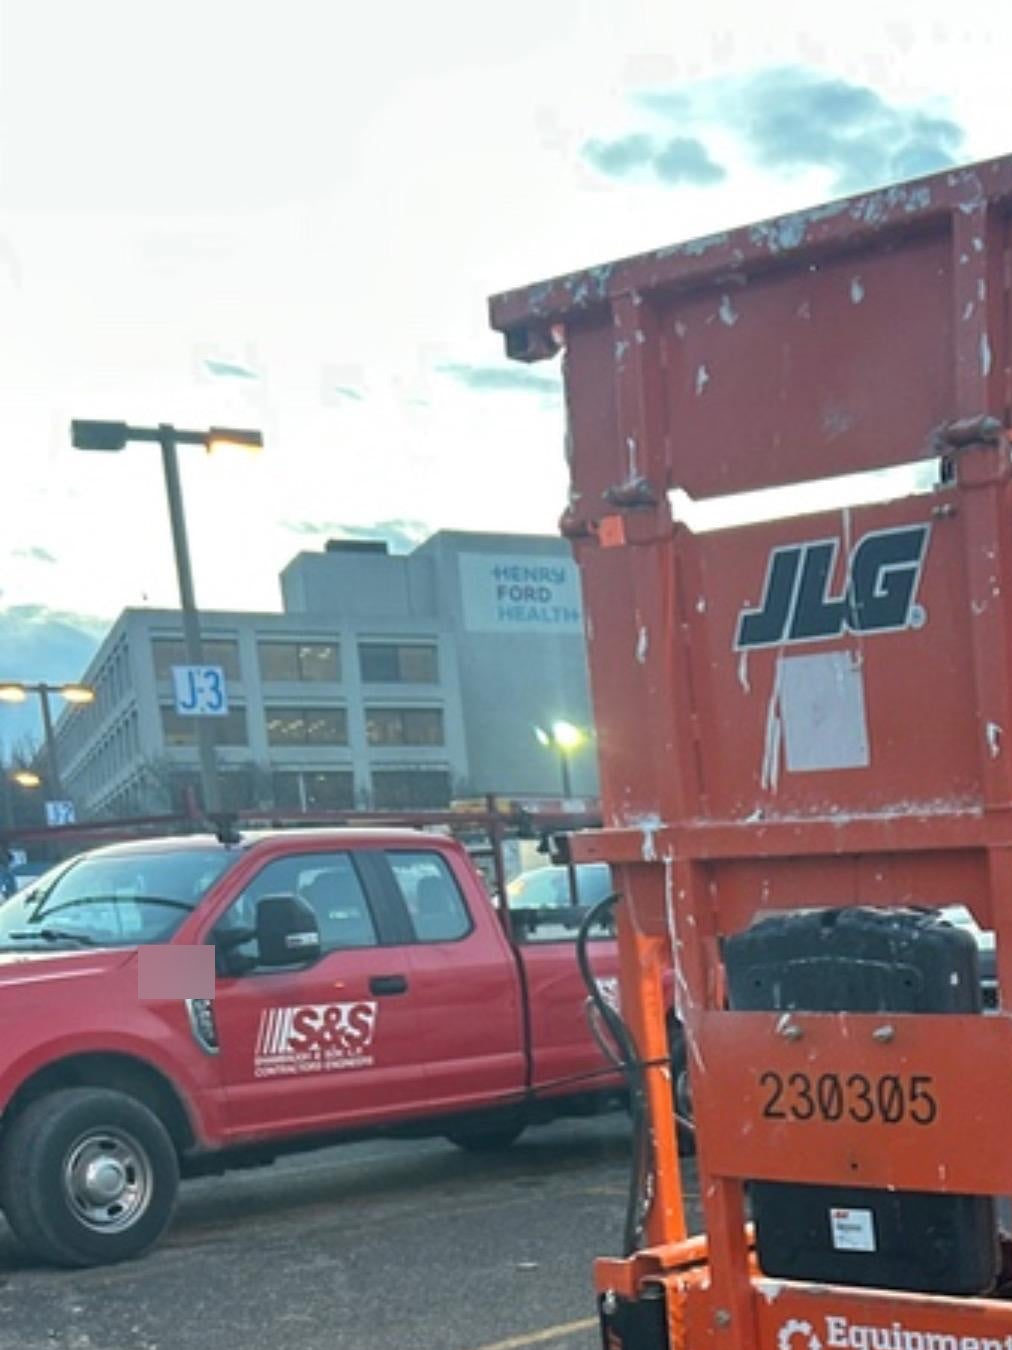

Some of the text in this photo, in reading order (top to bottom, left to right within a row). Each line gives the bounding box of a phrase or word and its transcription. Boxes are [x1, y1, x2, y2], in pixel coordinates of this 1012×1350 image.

[491, 565, 566, 585] HENRY
[734, 524, 931, 650] JLG
[497, 585, 553, 602] FORD
[497, 605, 580, 623] HEALTH
[287, 1003, 374, 1054] S&S
[758, 1070, 938, 1126] 230305
